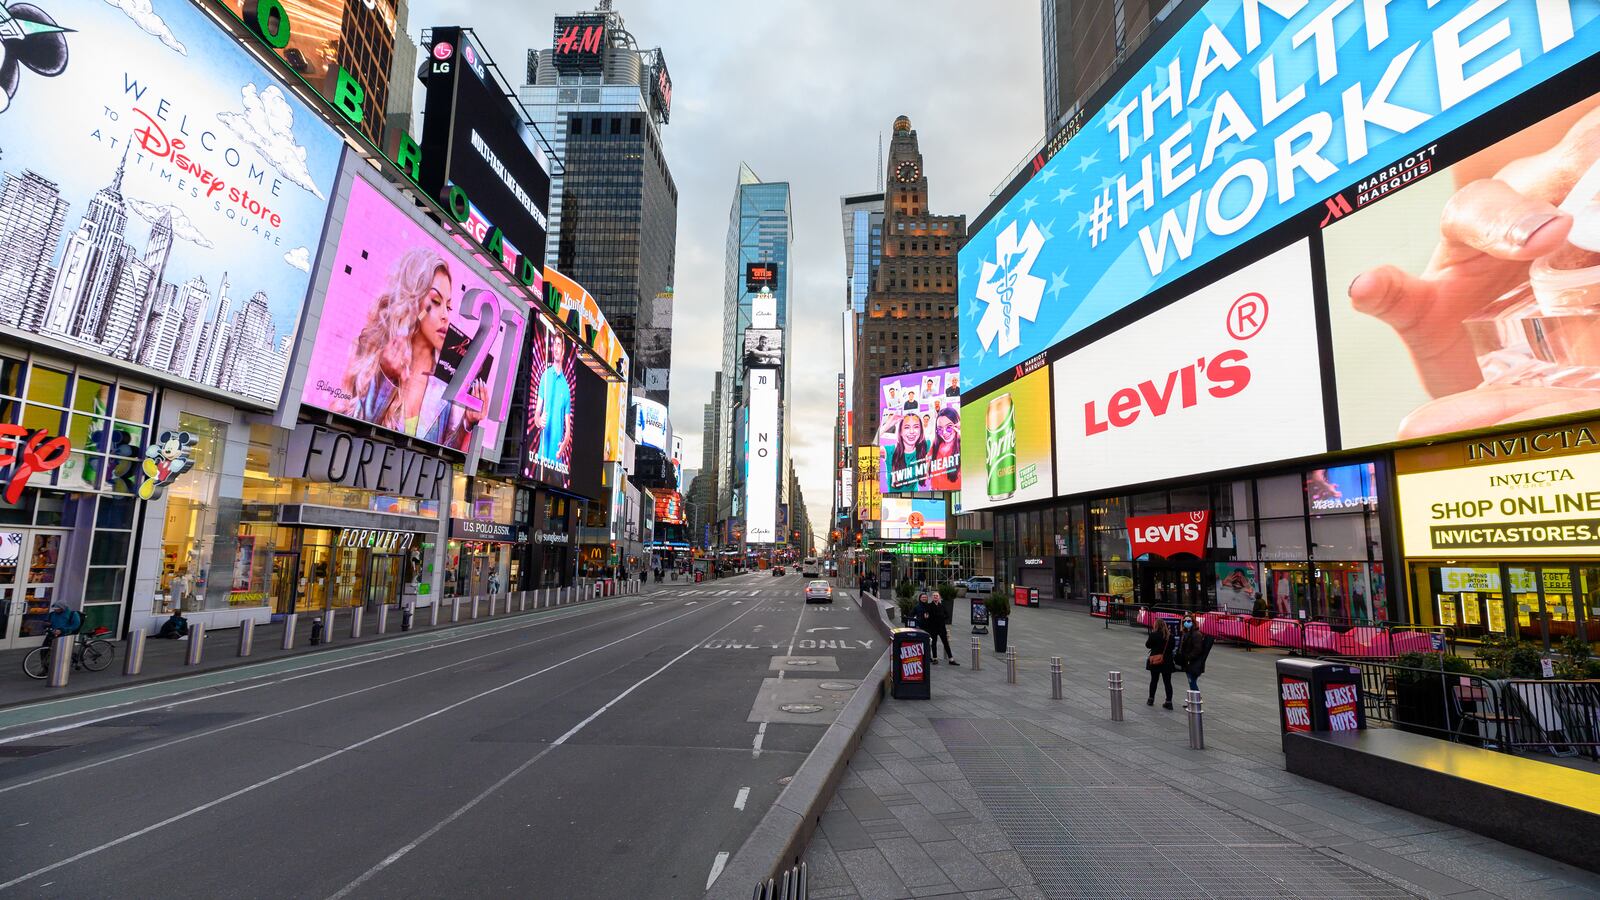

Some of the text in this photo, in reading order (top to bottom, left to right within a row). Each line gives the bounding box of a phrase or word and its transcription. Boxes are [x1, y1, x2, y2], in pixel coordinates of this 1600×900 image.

[432, 62, 450, 73] LG
[472, 58, 485, 80] LG
[124, 72, 282, 197] WELCOME
[1047, 108, 1085, 152] MARRIOTT
[1048, 123, 1081, 160] MARQUIS
[104, 105, 119, 122] TO
[228, 187, 281, 228] store
[1358, 144, 1438, 193] MARRIOTT
[91, 129, 281, 247] AT TIMES SQUARE
[1359, 162, 1429, 204] MARQUIS
[758, 376, 767, 385] 70
[1466, 427, 1598, 461] INVICTA
[302, 424, 447, 500] FOREVER
[890, 466, 913, 488] TWIN
[915, 463, 929, 477] MY
[930, 453, 960, 472] HEART
[1490, 468, 1575, 487] INVICTA
[1431, 490, 1600, 519] SHOP ONLINE
[463, 521, 475, 532] U.S.
[475, 523, 493, 534] POLO
[1435, 524, 1600, 545] INVICTASTORES.
[339, 528, 415, 550] FOREVER 21
[799, 639, 874, 649] ONLY
[900, 643, 925, 659] JERSEY
[903, 661, 923, 677] BOYS
[1281, 682, 1310, 700] JERSEY
[1325, 684, 1358, 708] JERSEY
[1286, 707, 1310, 725] BOYS
[1330, 711, 1358, 731] BOYS
